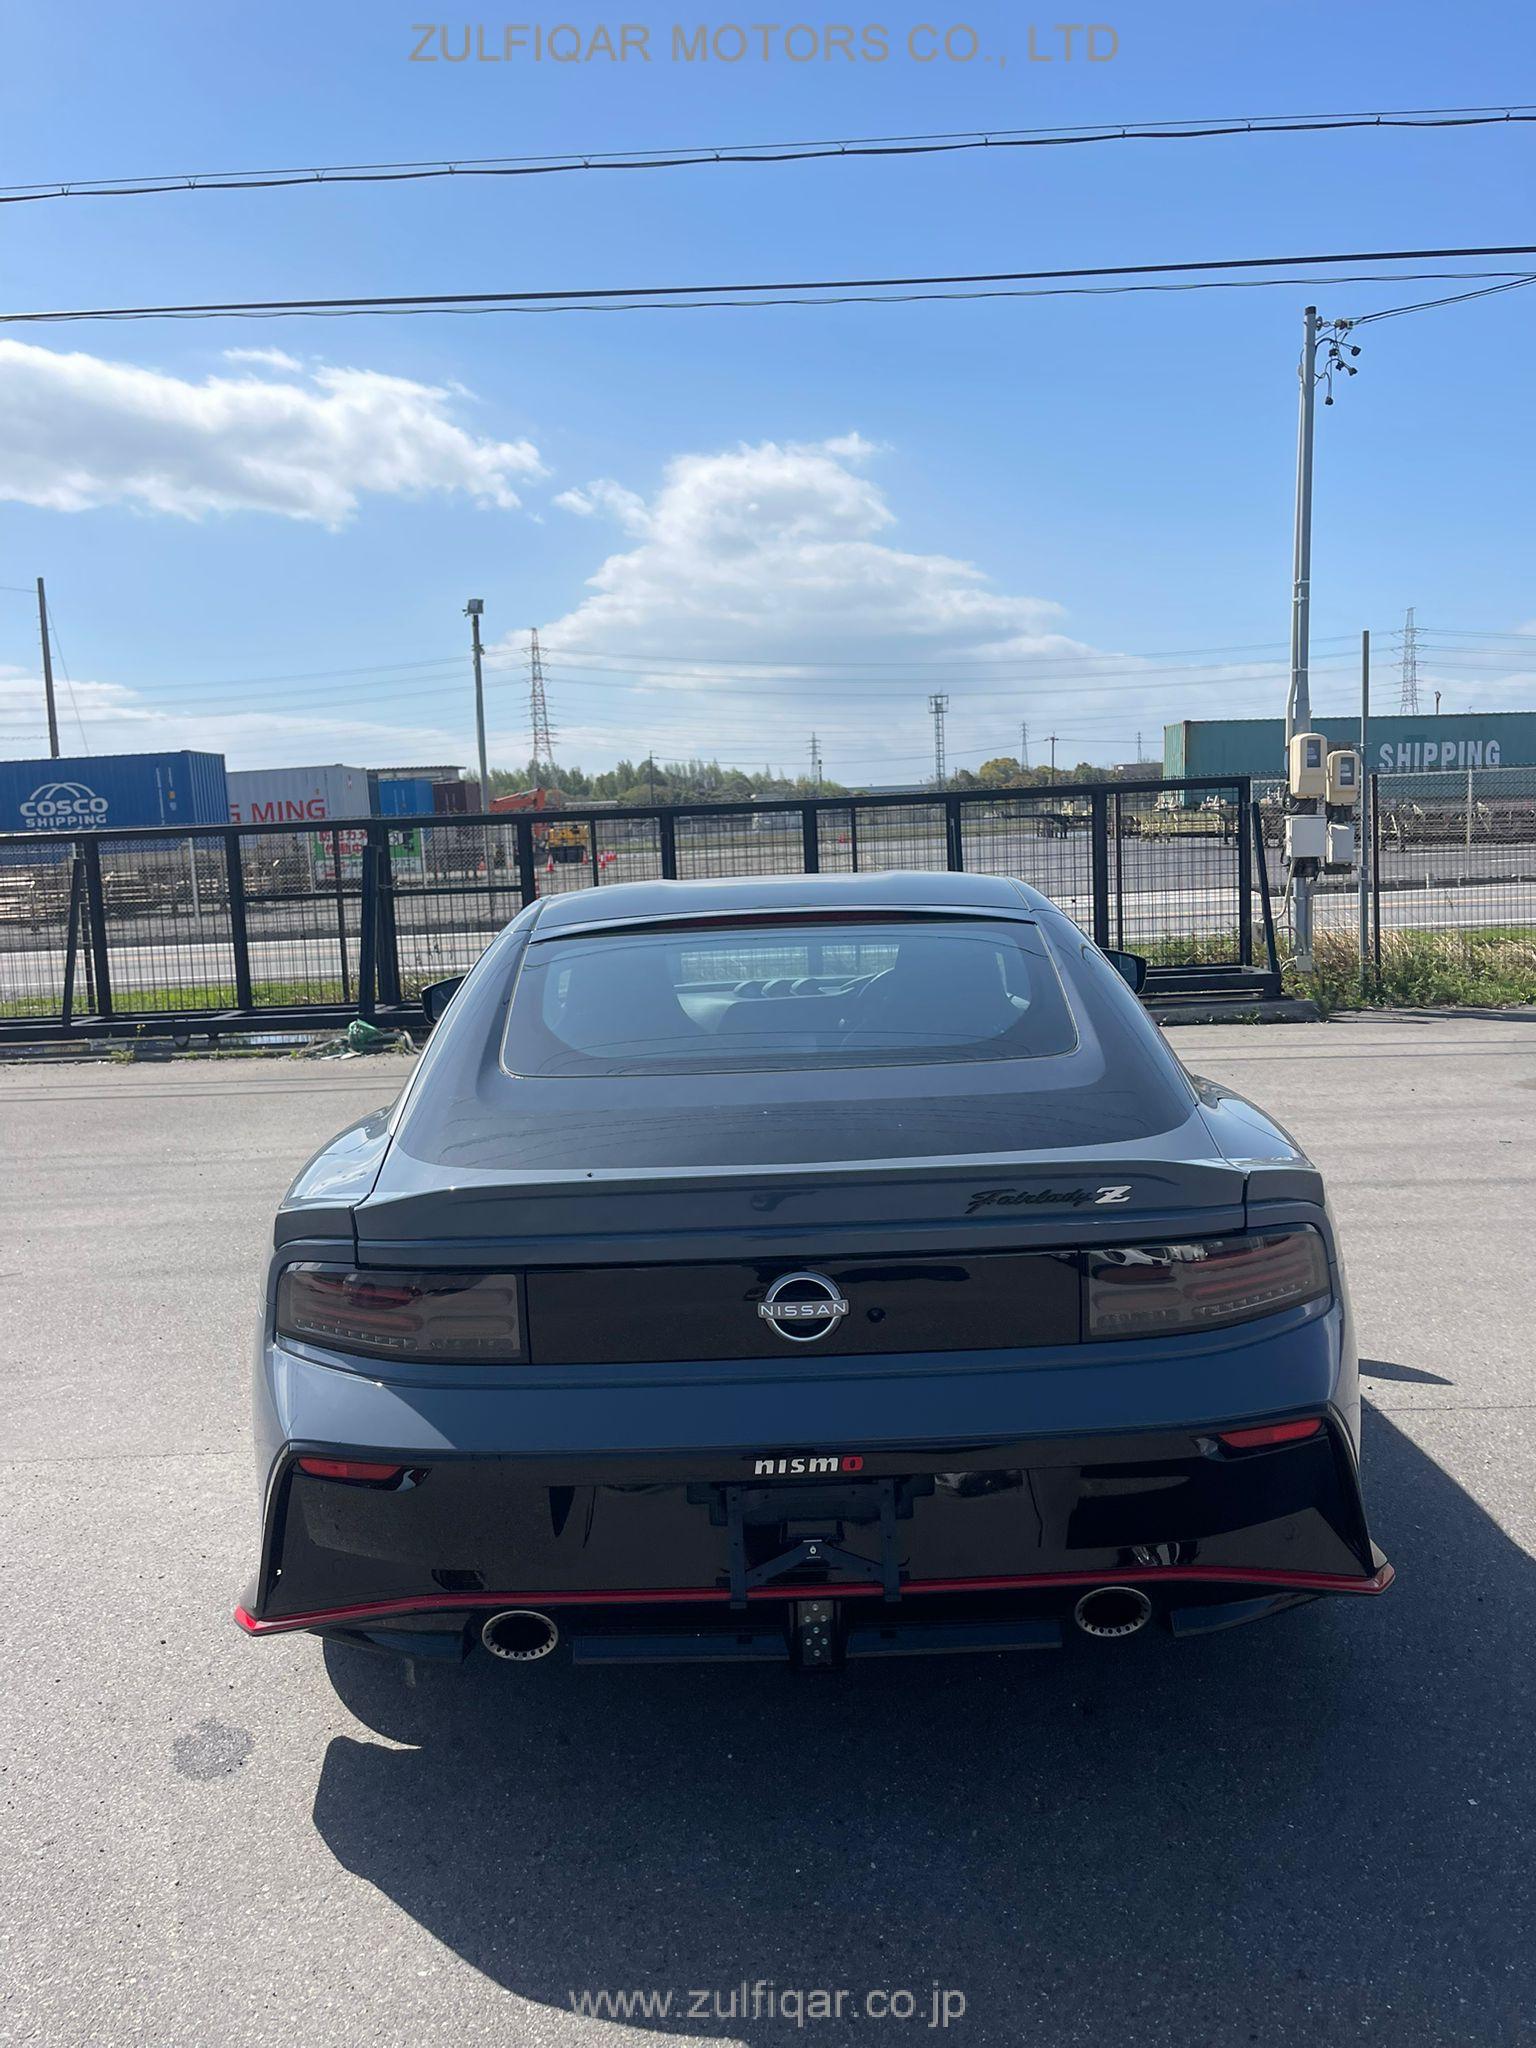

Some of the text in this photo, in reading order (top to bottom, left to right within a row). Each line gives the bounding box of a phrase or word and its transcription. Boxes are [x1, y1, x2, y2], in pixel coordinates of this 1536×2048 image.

[1379, 740, 1500, 772] SHIPPING
[20, 798, 108, 817] COSCO
[251, 799, 325, 823] MING
[25, 814, 107, 828] SHIPPING
[965, 1185, 1132, 1214] Fairlady Z
[760, 1303, 846, 1316] NISSAN
[754, 1456, 864, 1475] nismo
